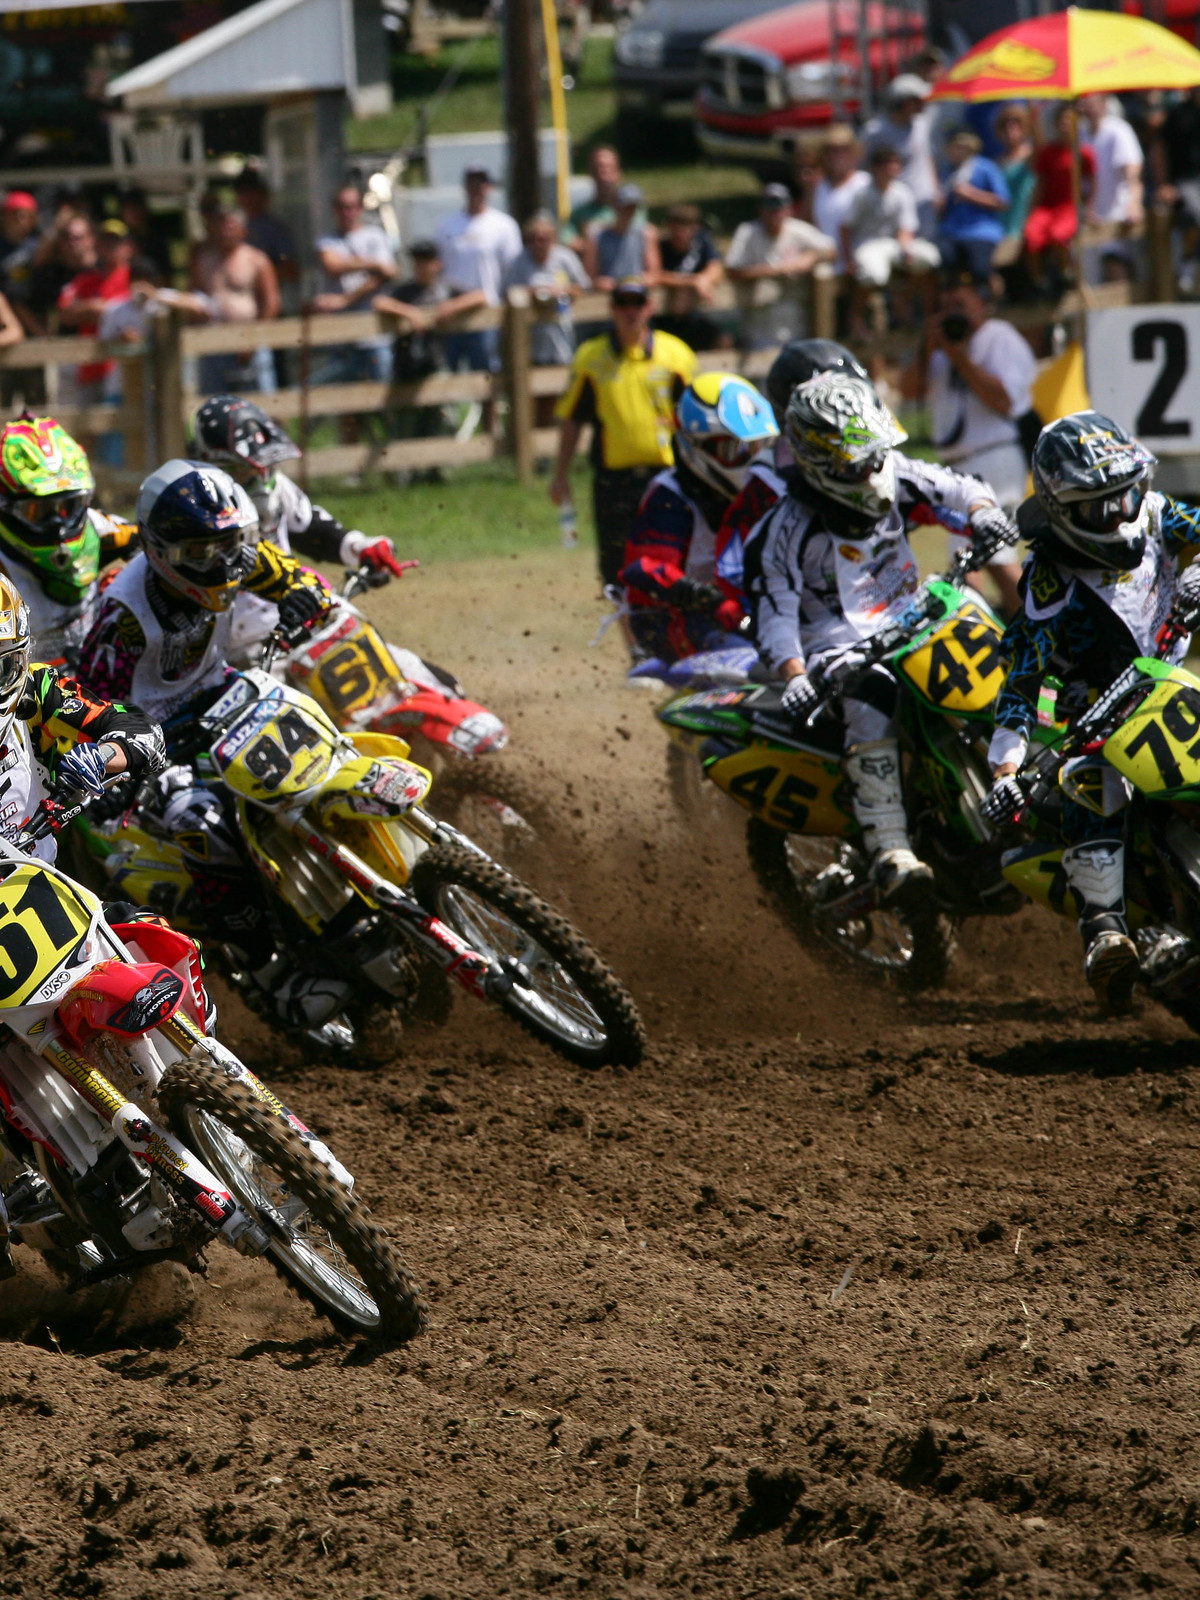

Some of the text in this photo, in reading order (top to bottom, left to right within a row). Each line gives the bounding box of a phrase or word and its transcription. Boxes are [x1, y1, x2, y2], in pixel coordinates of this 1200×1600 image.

[1132, 321, 1191, 437] 2
[320, 634, 389, 711] 61
[928, 609, 1003, 704] 45
[221, 697, 281, 757] SUZUKI
[245, 708, 320, 791] 94
[1124, 688, 1200, 789] 79
[729, 765, 819, 829] 45
[41, 978, 64, 1000] DVS
[147, 990, 179, 1018] HONDA
[144, 1143, 186, 1185] fitness
[150, 1132, 189, 1171] planet
